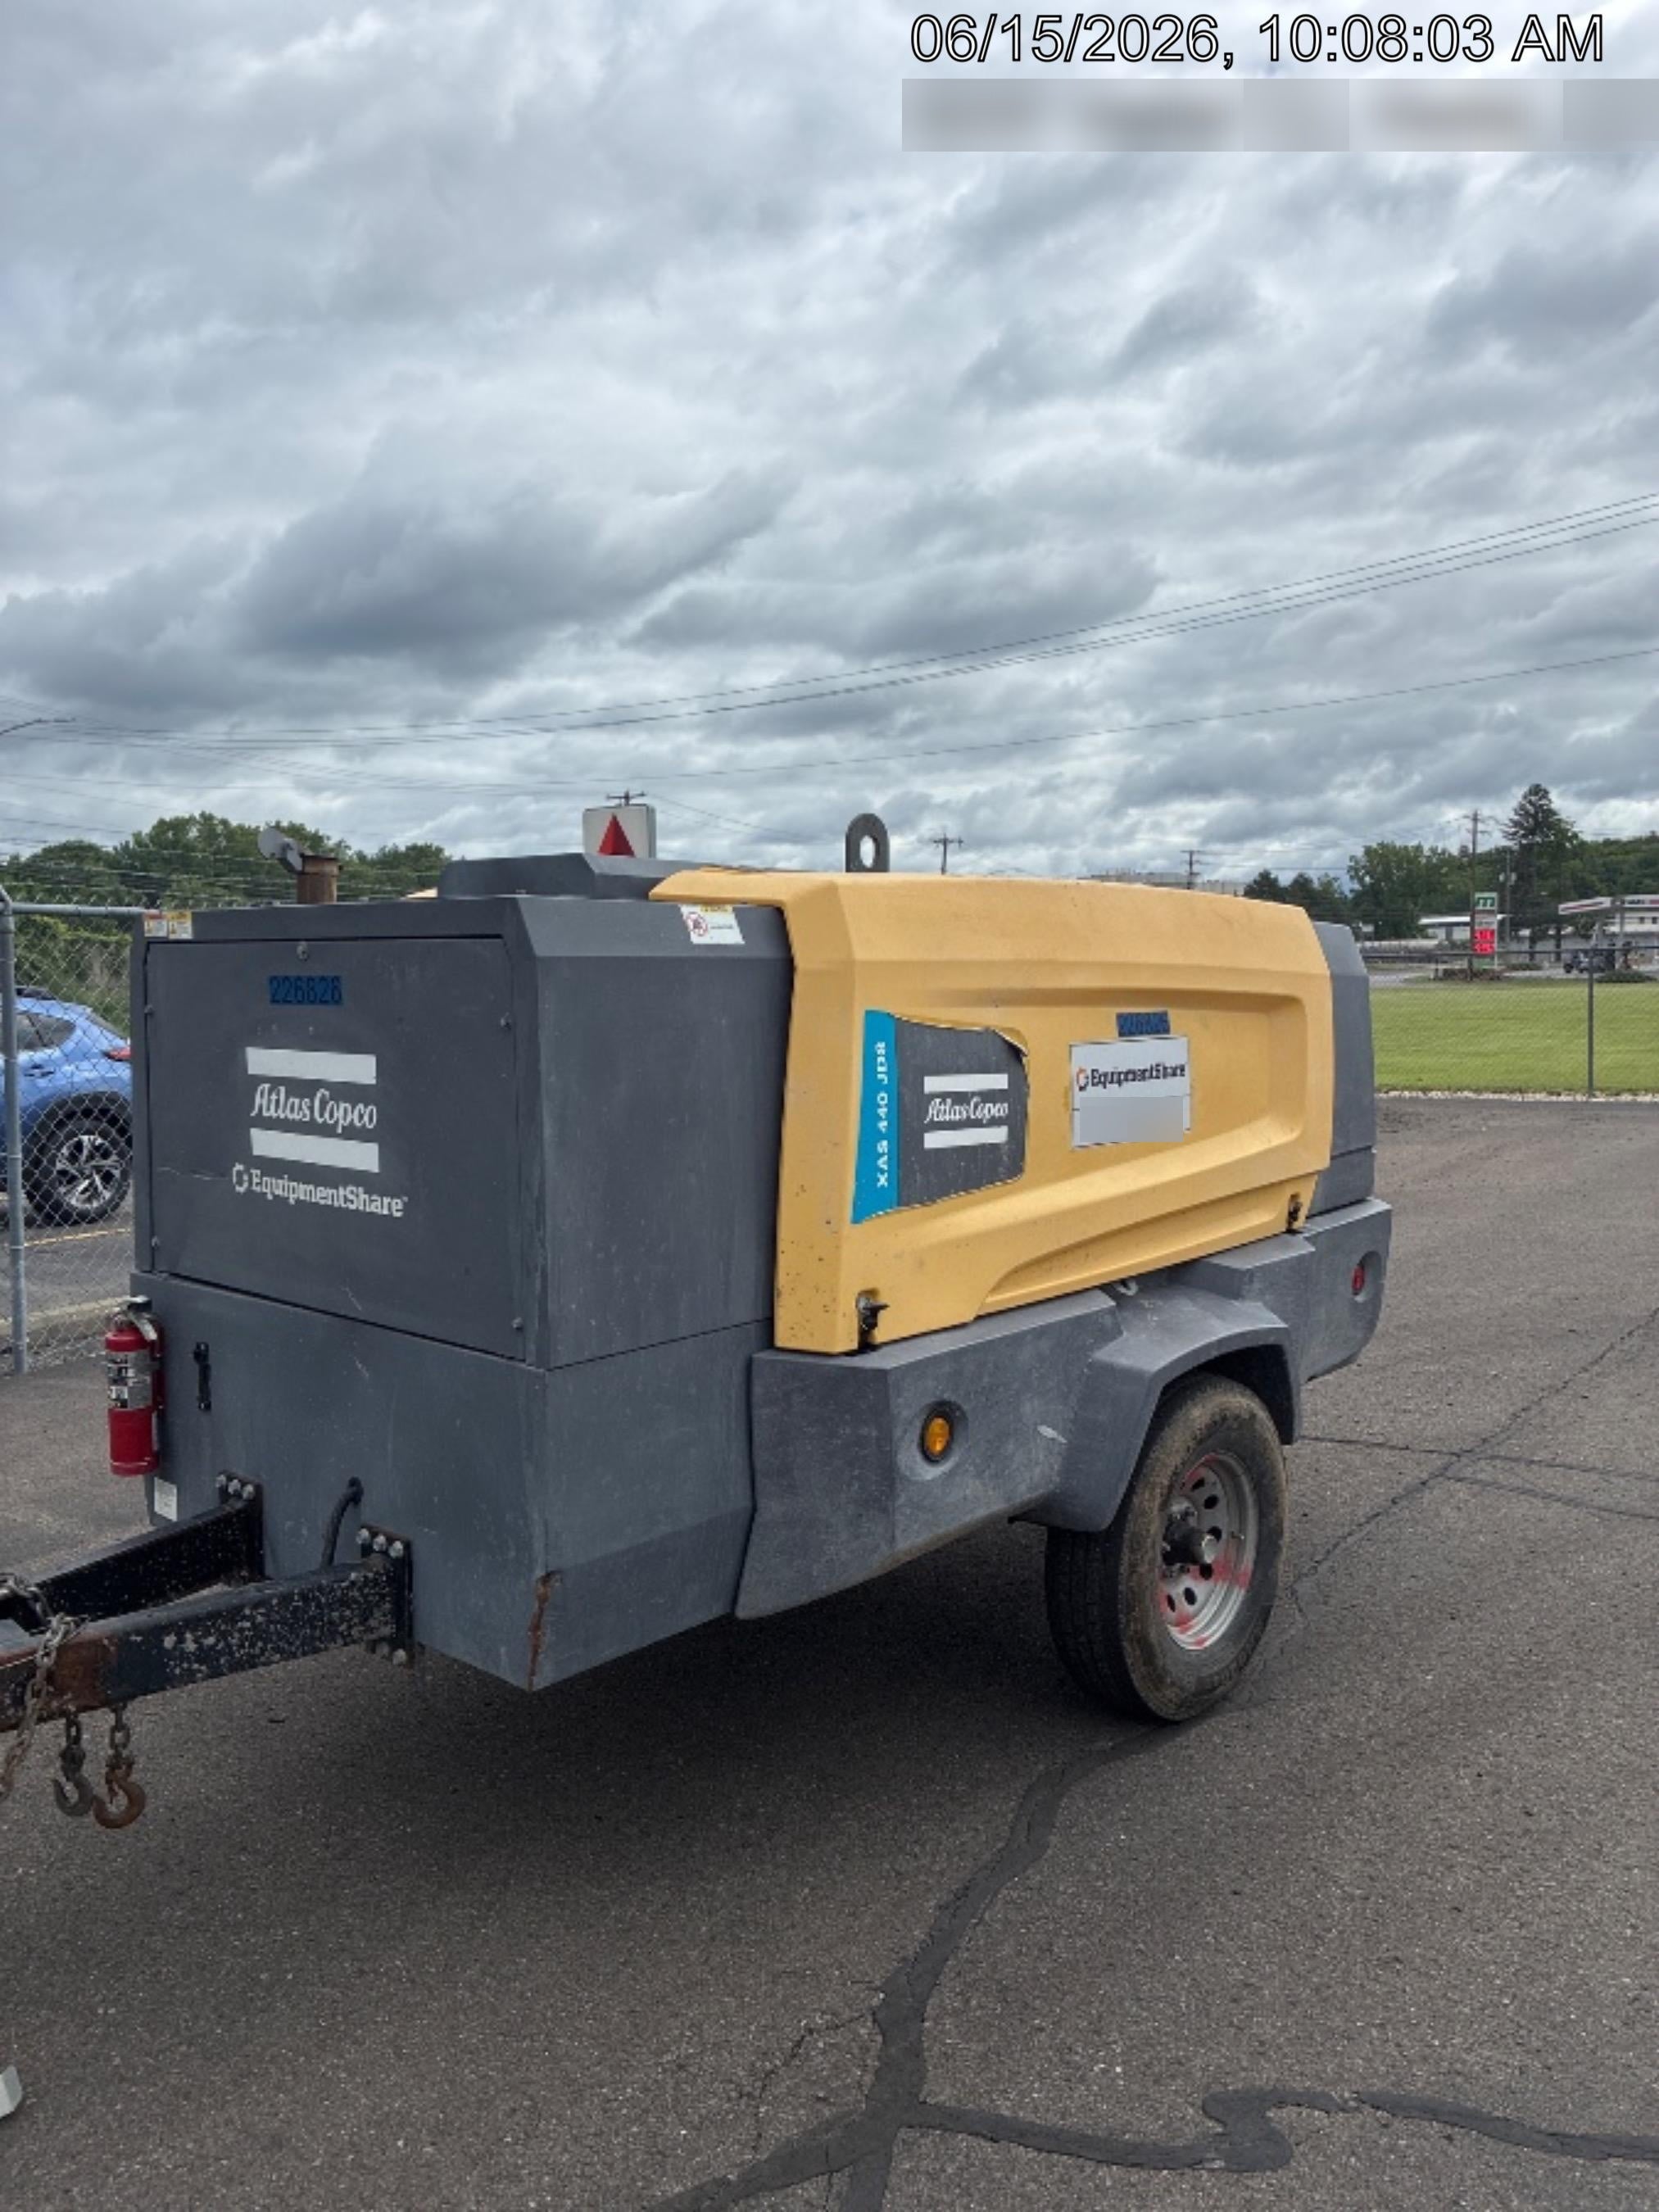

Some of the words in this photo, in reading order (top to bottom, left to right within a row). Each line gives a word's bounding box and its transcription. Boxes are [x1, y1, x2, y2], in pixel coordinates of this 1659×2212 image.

[1090, 1063, 1185, 1089] EquipmentShare
[251, 1083, 310, 1122] Atlas
[314, 1088, 376, 1134] Copco
[877, 1091, 888, 1132] 440
[924, 1099, 968, 1123] Atlas
[969, 1096, 1009, 1122] Copco
[877, 1140, 888, 1187] XAS
[250, 1168, 404, 1217] EquipmentShare
